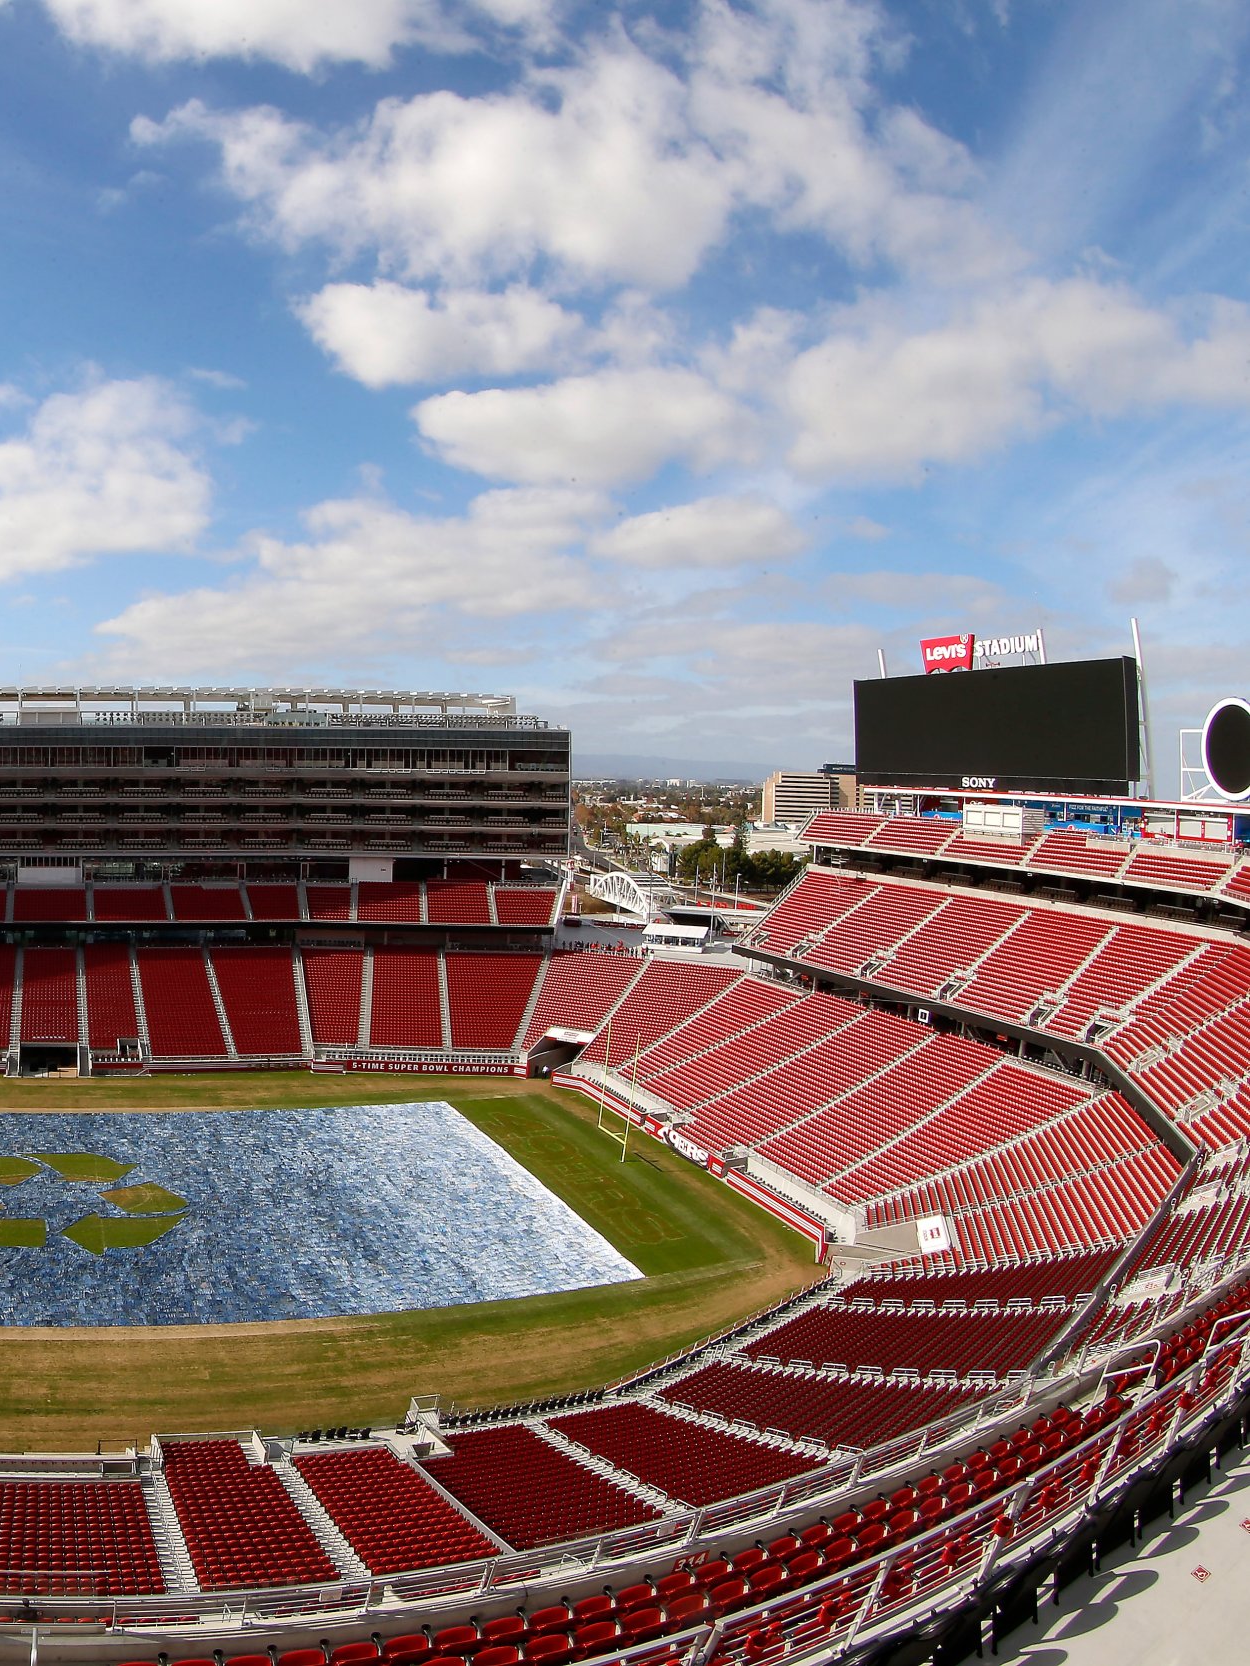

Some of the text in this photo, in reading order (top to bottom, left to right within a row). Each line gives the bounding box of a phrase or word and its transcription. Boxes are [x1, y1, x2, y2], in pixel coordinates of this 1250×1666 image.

[973, 634, 1039, 657] STADIUM
[961, 776, 996, 788] SONY
[352, 1062, 509, 1073] 5-TIME SUPER BOWL CHAMPIONS
